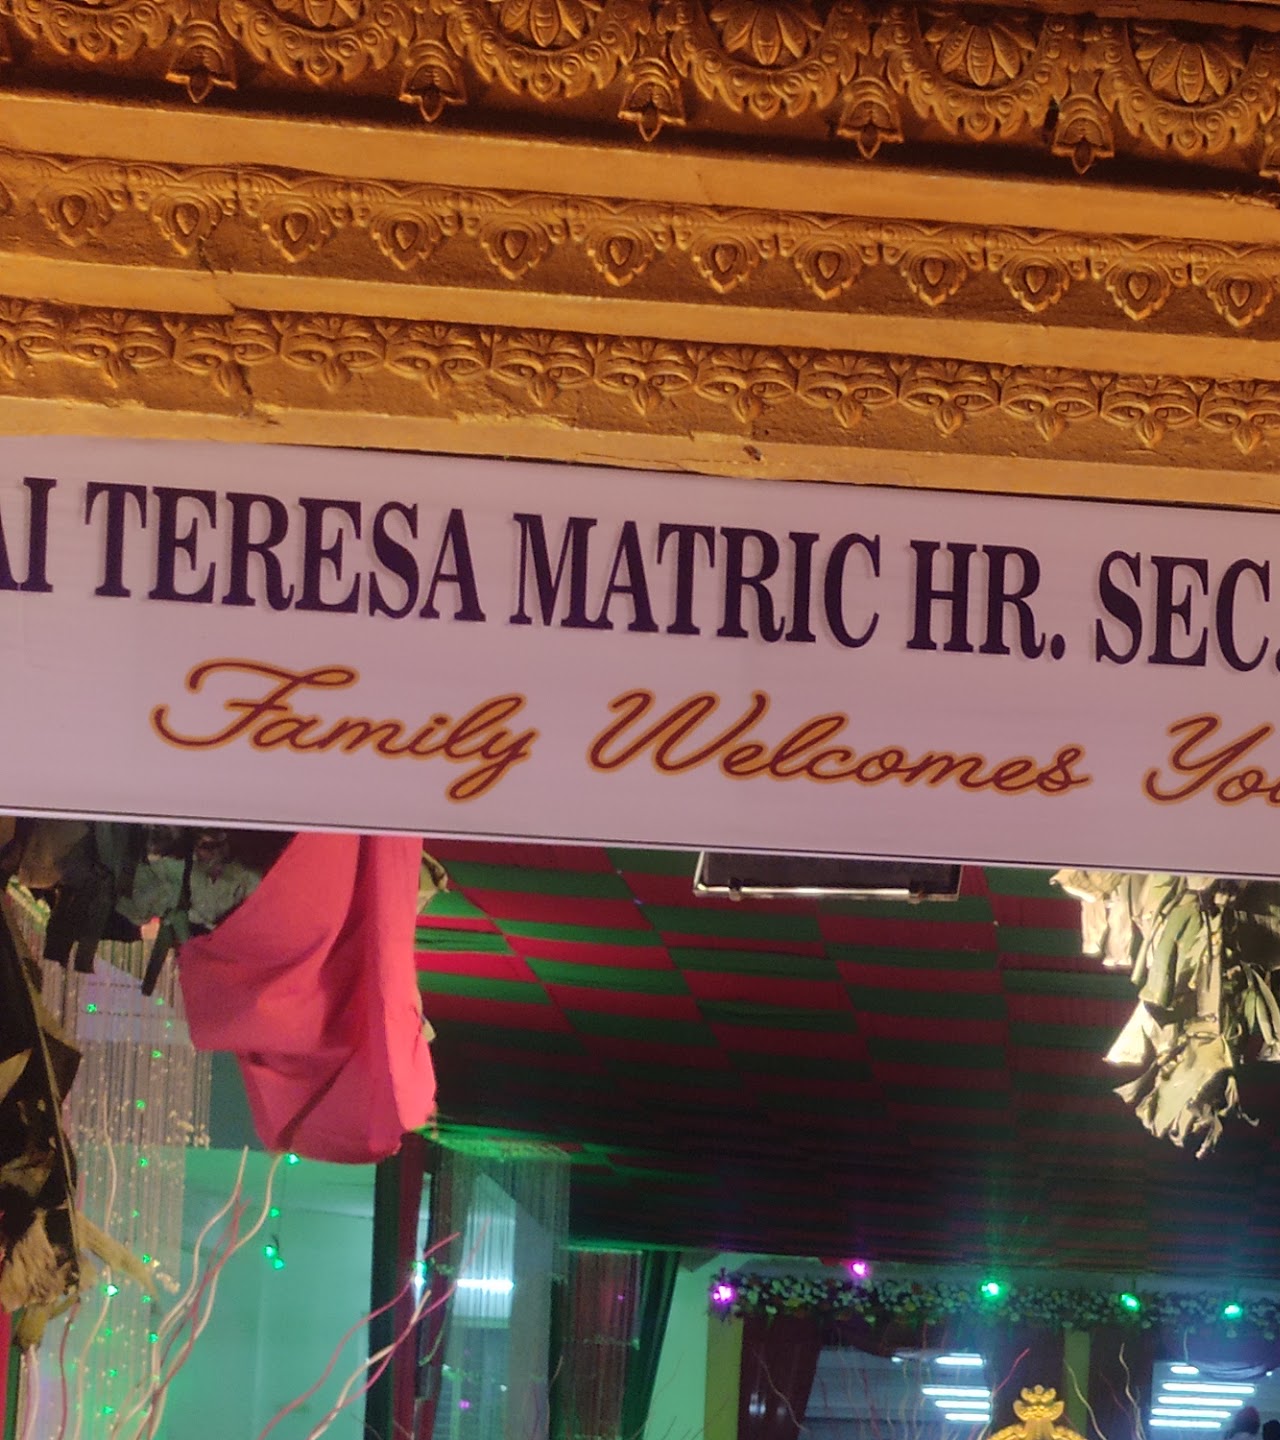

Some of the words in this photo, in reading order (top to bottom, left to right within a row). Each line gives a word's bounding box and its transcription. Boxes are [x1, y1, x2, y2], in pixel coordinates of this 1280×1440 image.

[85, 481, 486, 622] TERESA
[509, 512, 882, 648] MATRIC
[906, 540, 1066, 661] HR.
[151, 657, 540, 803] Family
[588, 687, 1092, 797] Welcomes
